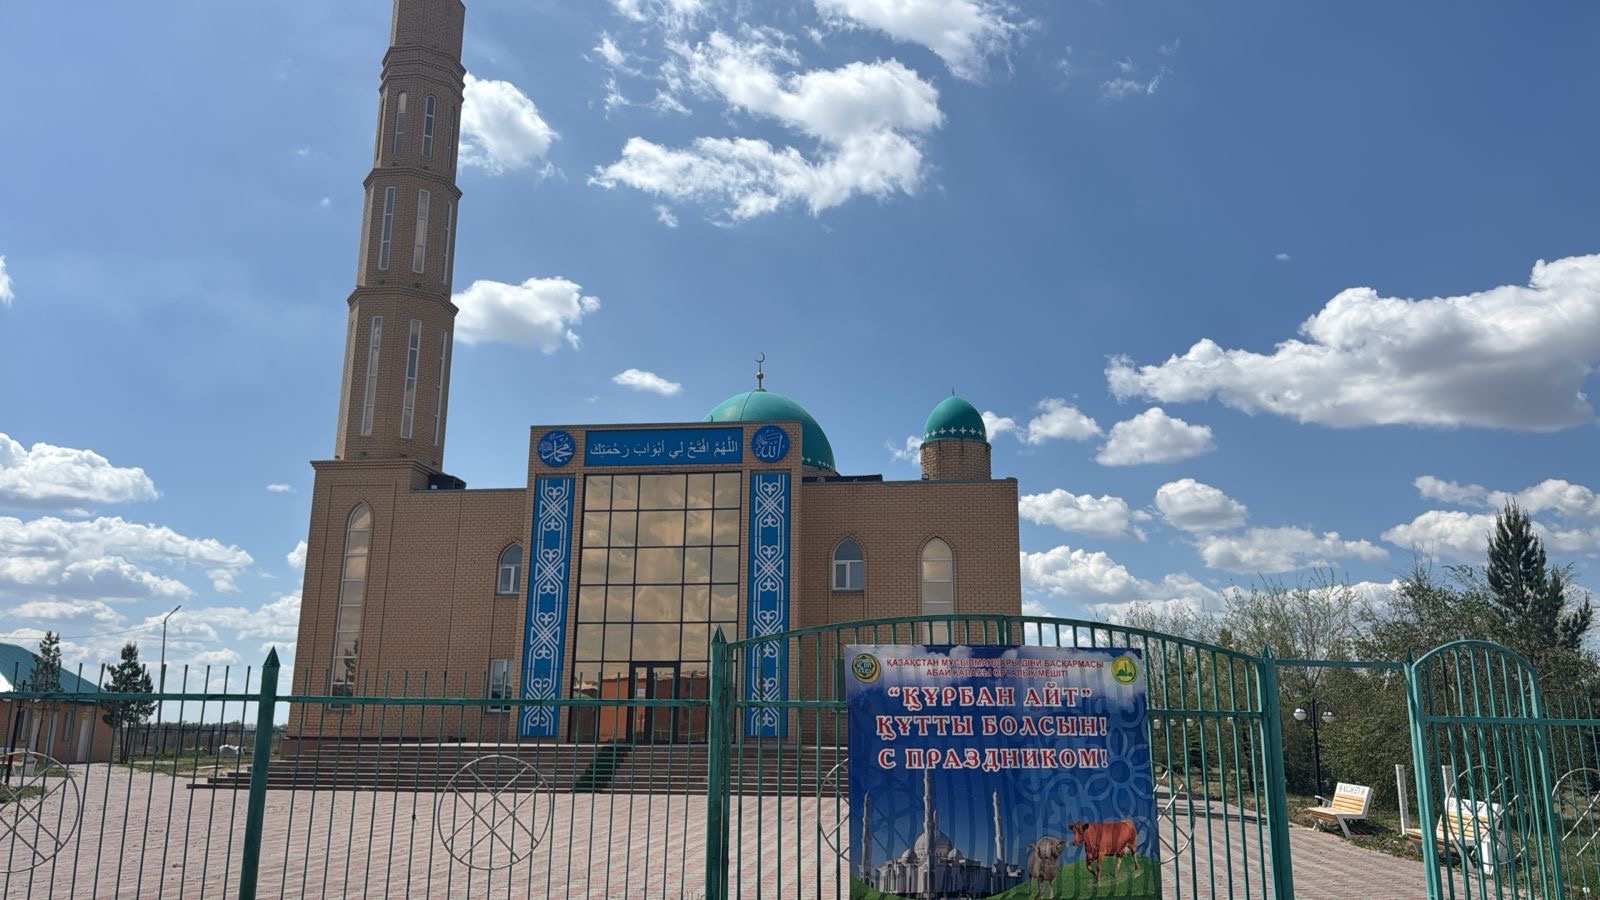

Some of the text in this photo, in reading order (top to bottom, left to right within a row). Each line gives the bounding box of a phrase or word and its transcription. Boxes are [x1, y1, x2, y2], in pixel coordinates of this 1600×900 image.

[886, 658, 939, 667] ҚАЗАҚСТАН
[1044, 659, 1104, 669] БАСҚАРМАСЫ
[926, 668, 951, 677] АБАЙ
[875, 715, 1107, 740] ҚҰТТЫ БОЛСЫН!
[877, 748, 1109, 772] С ПРАЗДНИКОМ!
